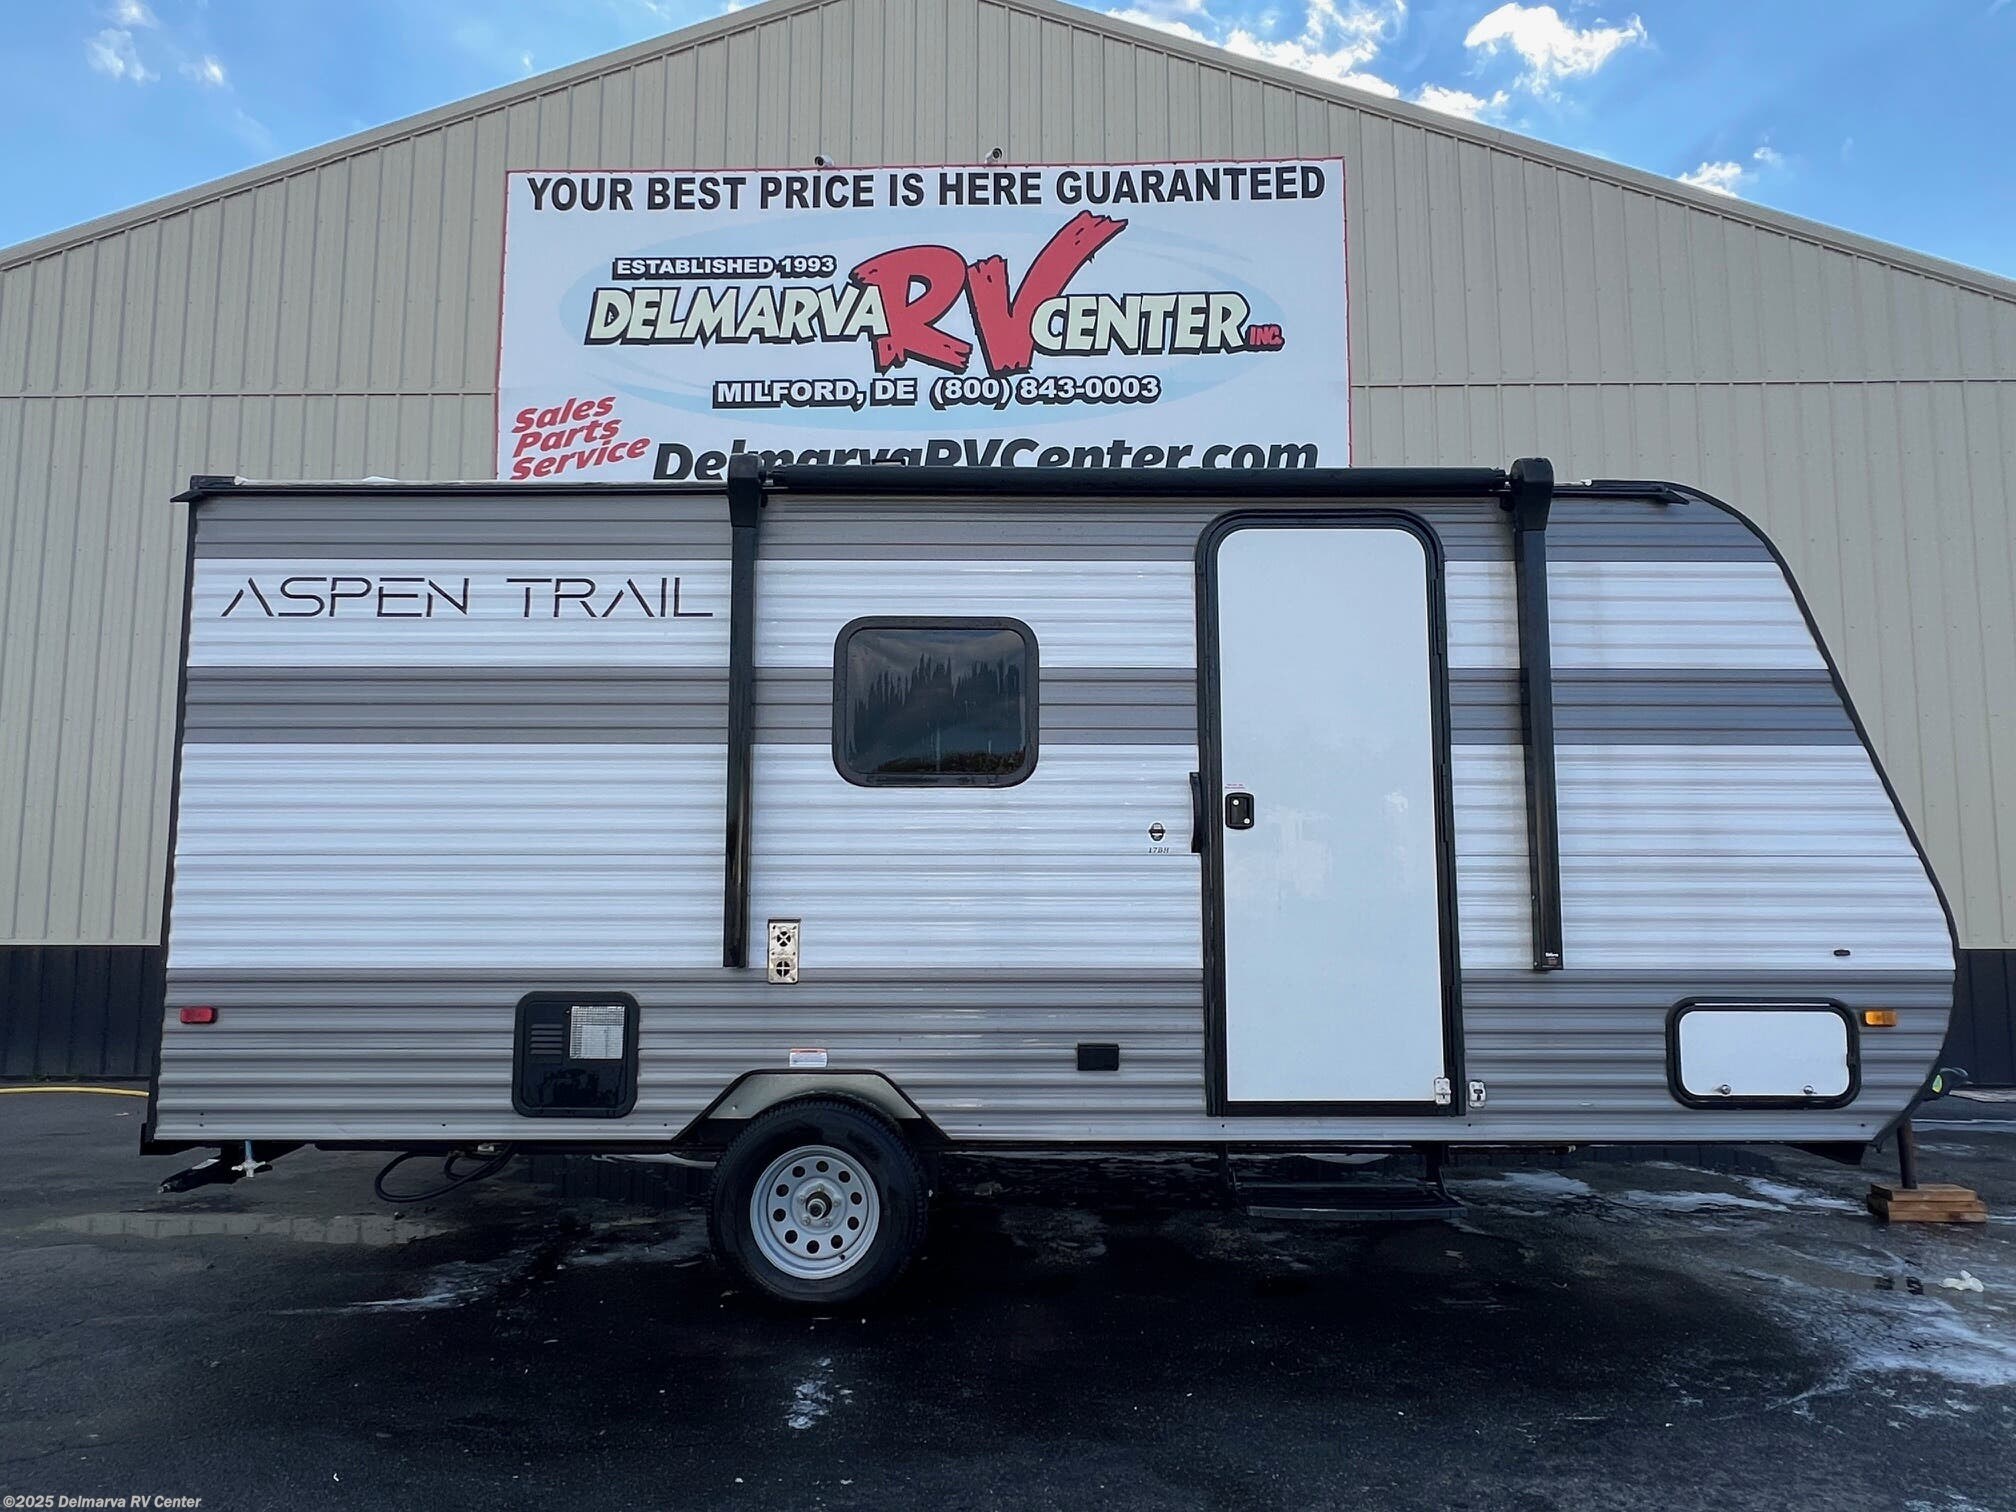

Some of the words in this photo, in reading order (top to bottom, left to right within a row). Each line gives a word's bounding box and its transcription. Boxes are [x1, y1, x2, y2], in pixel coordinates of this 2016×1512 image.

[527, 177, 633, 211] YOUR
[647, 176, 746, 210] BEST
[760, 174, 874, 209] PRICE
[889, 174, 924, 206] IS
[938, 172, 1042, 206] HERE
[1056, 166, 1326, 204] GUARANTEED
[614, 258, 774, 279] ESTABLISHED
[781, 256, 836, 276] 1993
[585, 285, 891, 346] DELMARVA
[849, 210, 1128, 376] RV
[1030, 291, 1250, 355] CENTER
[715, 380, 866, 410] MILFORD,
[870, 378, 918, 404] DE
[931, 377, 1012, 409] (800)
[1016, 376, 1162, 403] 843-0003
[511, 396, 617, 433] Sales
[512, 419, 622, 458] Parts
[509, 438, 651, 480] Service
[221, 577, 470, 618] ASPEN
[506, 577, 714, 618] TRAIL
